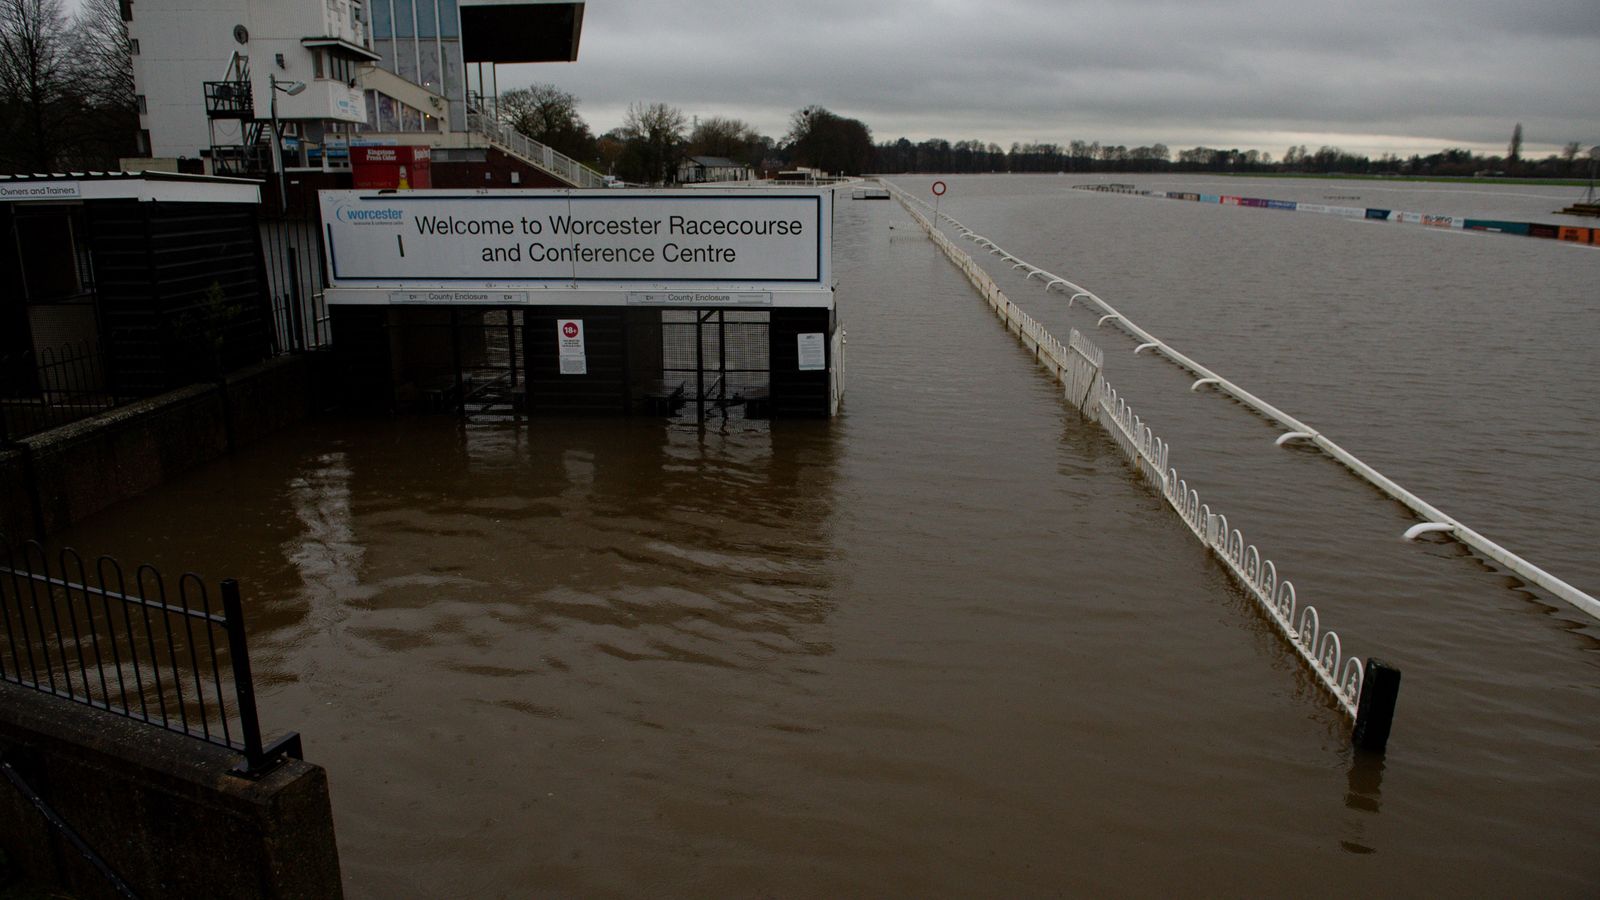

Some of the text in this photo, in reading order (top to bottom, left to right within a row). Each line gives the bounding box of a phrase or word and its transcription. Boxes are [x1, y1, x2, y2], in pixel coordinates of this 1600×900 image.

[1, 188, 29, 196] Owners
[30, 187, 46, 195] and
[347, 208, 403, 220] worcester
[414, 215, 803, 235] Welcome to Worcester Racecourse
[481, 243, 736, 263] and Conference Centre
[428, 292, 453, 301] County
[455, 292, 488, 300] Enclosure
[668, 293, 730, 302] County Enclosure
[564, 326, 577, 334] 18+
